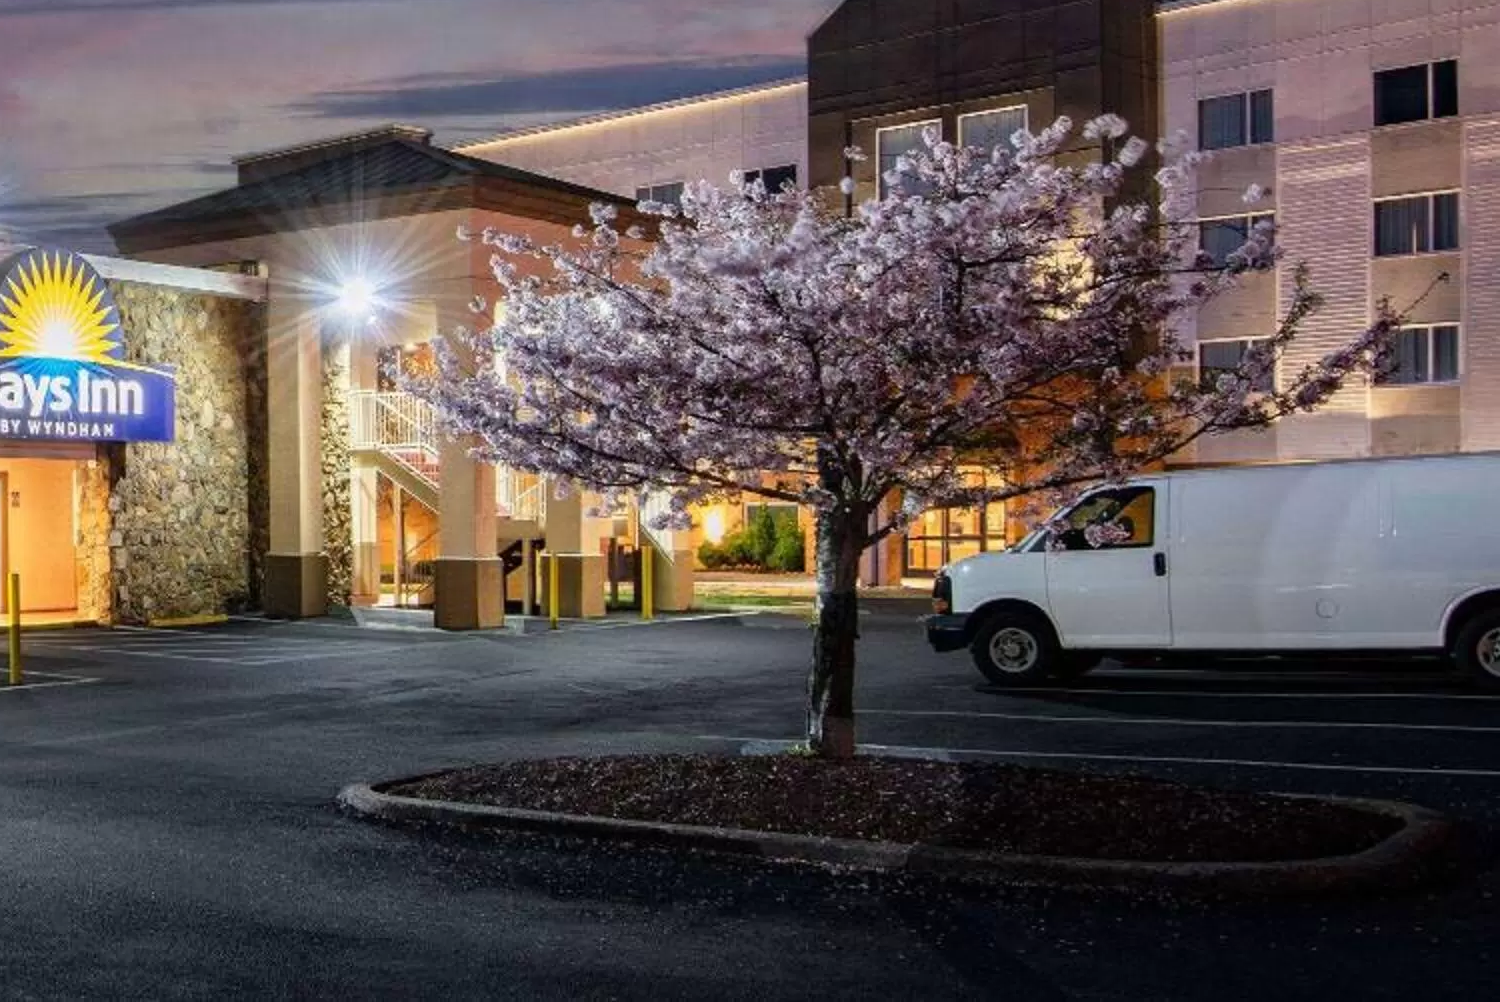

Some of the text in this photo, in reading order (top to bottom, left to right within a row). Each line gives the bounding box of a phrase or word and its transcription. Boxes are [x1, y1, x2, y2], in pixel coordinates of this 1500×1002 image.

[78, 369, 144, 415] Inn
[0, 419, 115, 437] BY WYNDHAM
